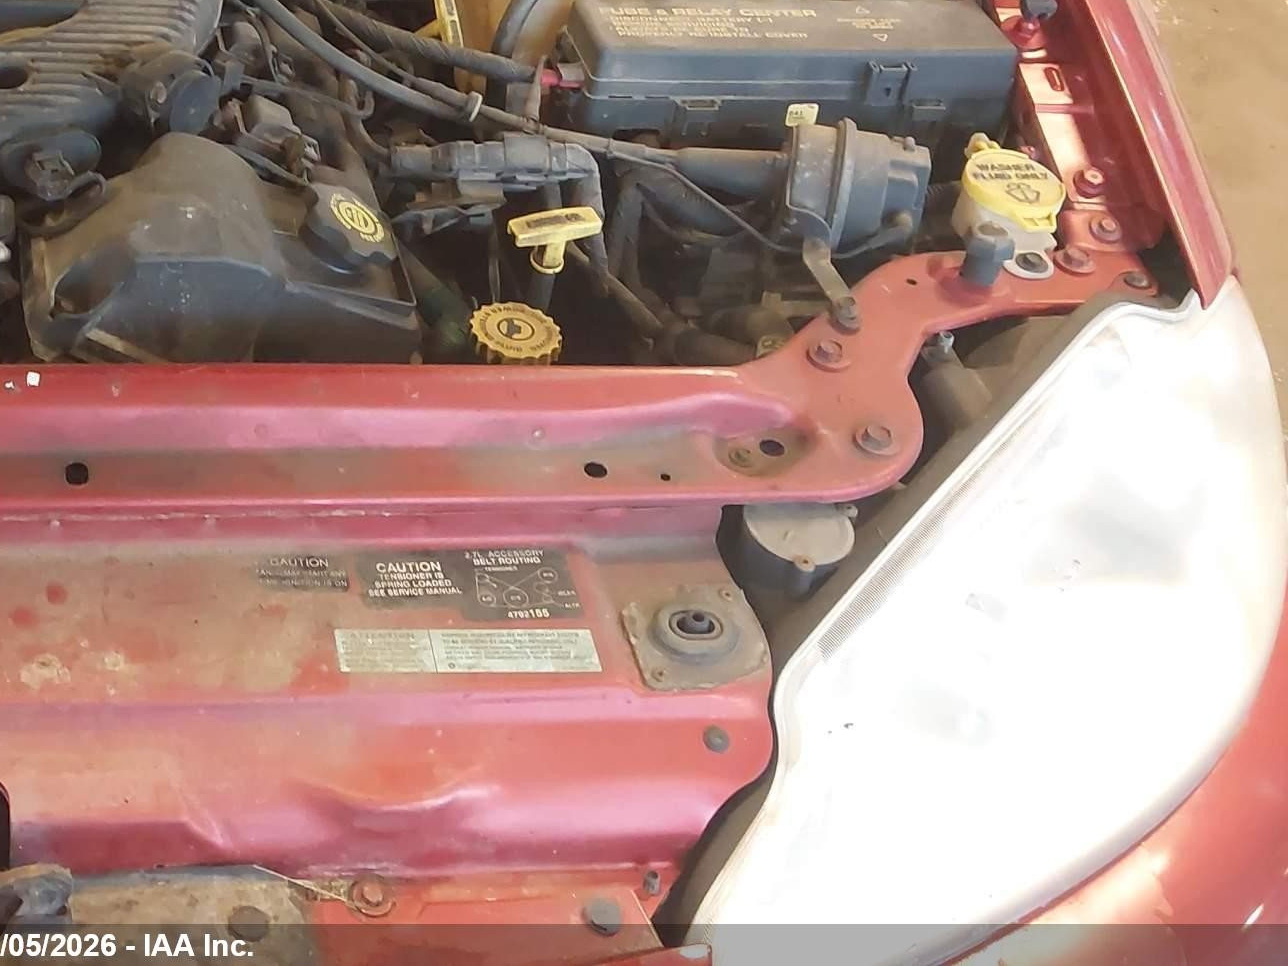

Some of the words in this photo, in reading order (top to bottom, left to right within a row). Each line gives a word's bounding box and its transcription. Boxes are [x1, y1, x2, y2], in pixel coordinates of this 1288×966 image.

[739, 9, 817, 18] CENTER
[975, 163, 1035, 171] WASHER
[270, 557, 329, 568] CAUTION
[375, 561, 442, 573] CAUTION
[378, 571, 431, 581] TENSIONER
[374, 579, 411, 588] SPRING
[412, 578, 452, 588] LOADED
[388, 587, 425, 597] SERVICE
[425, 586, 463, 596] MANUAL
